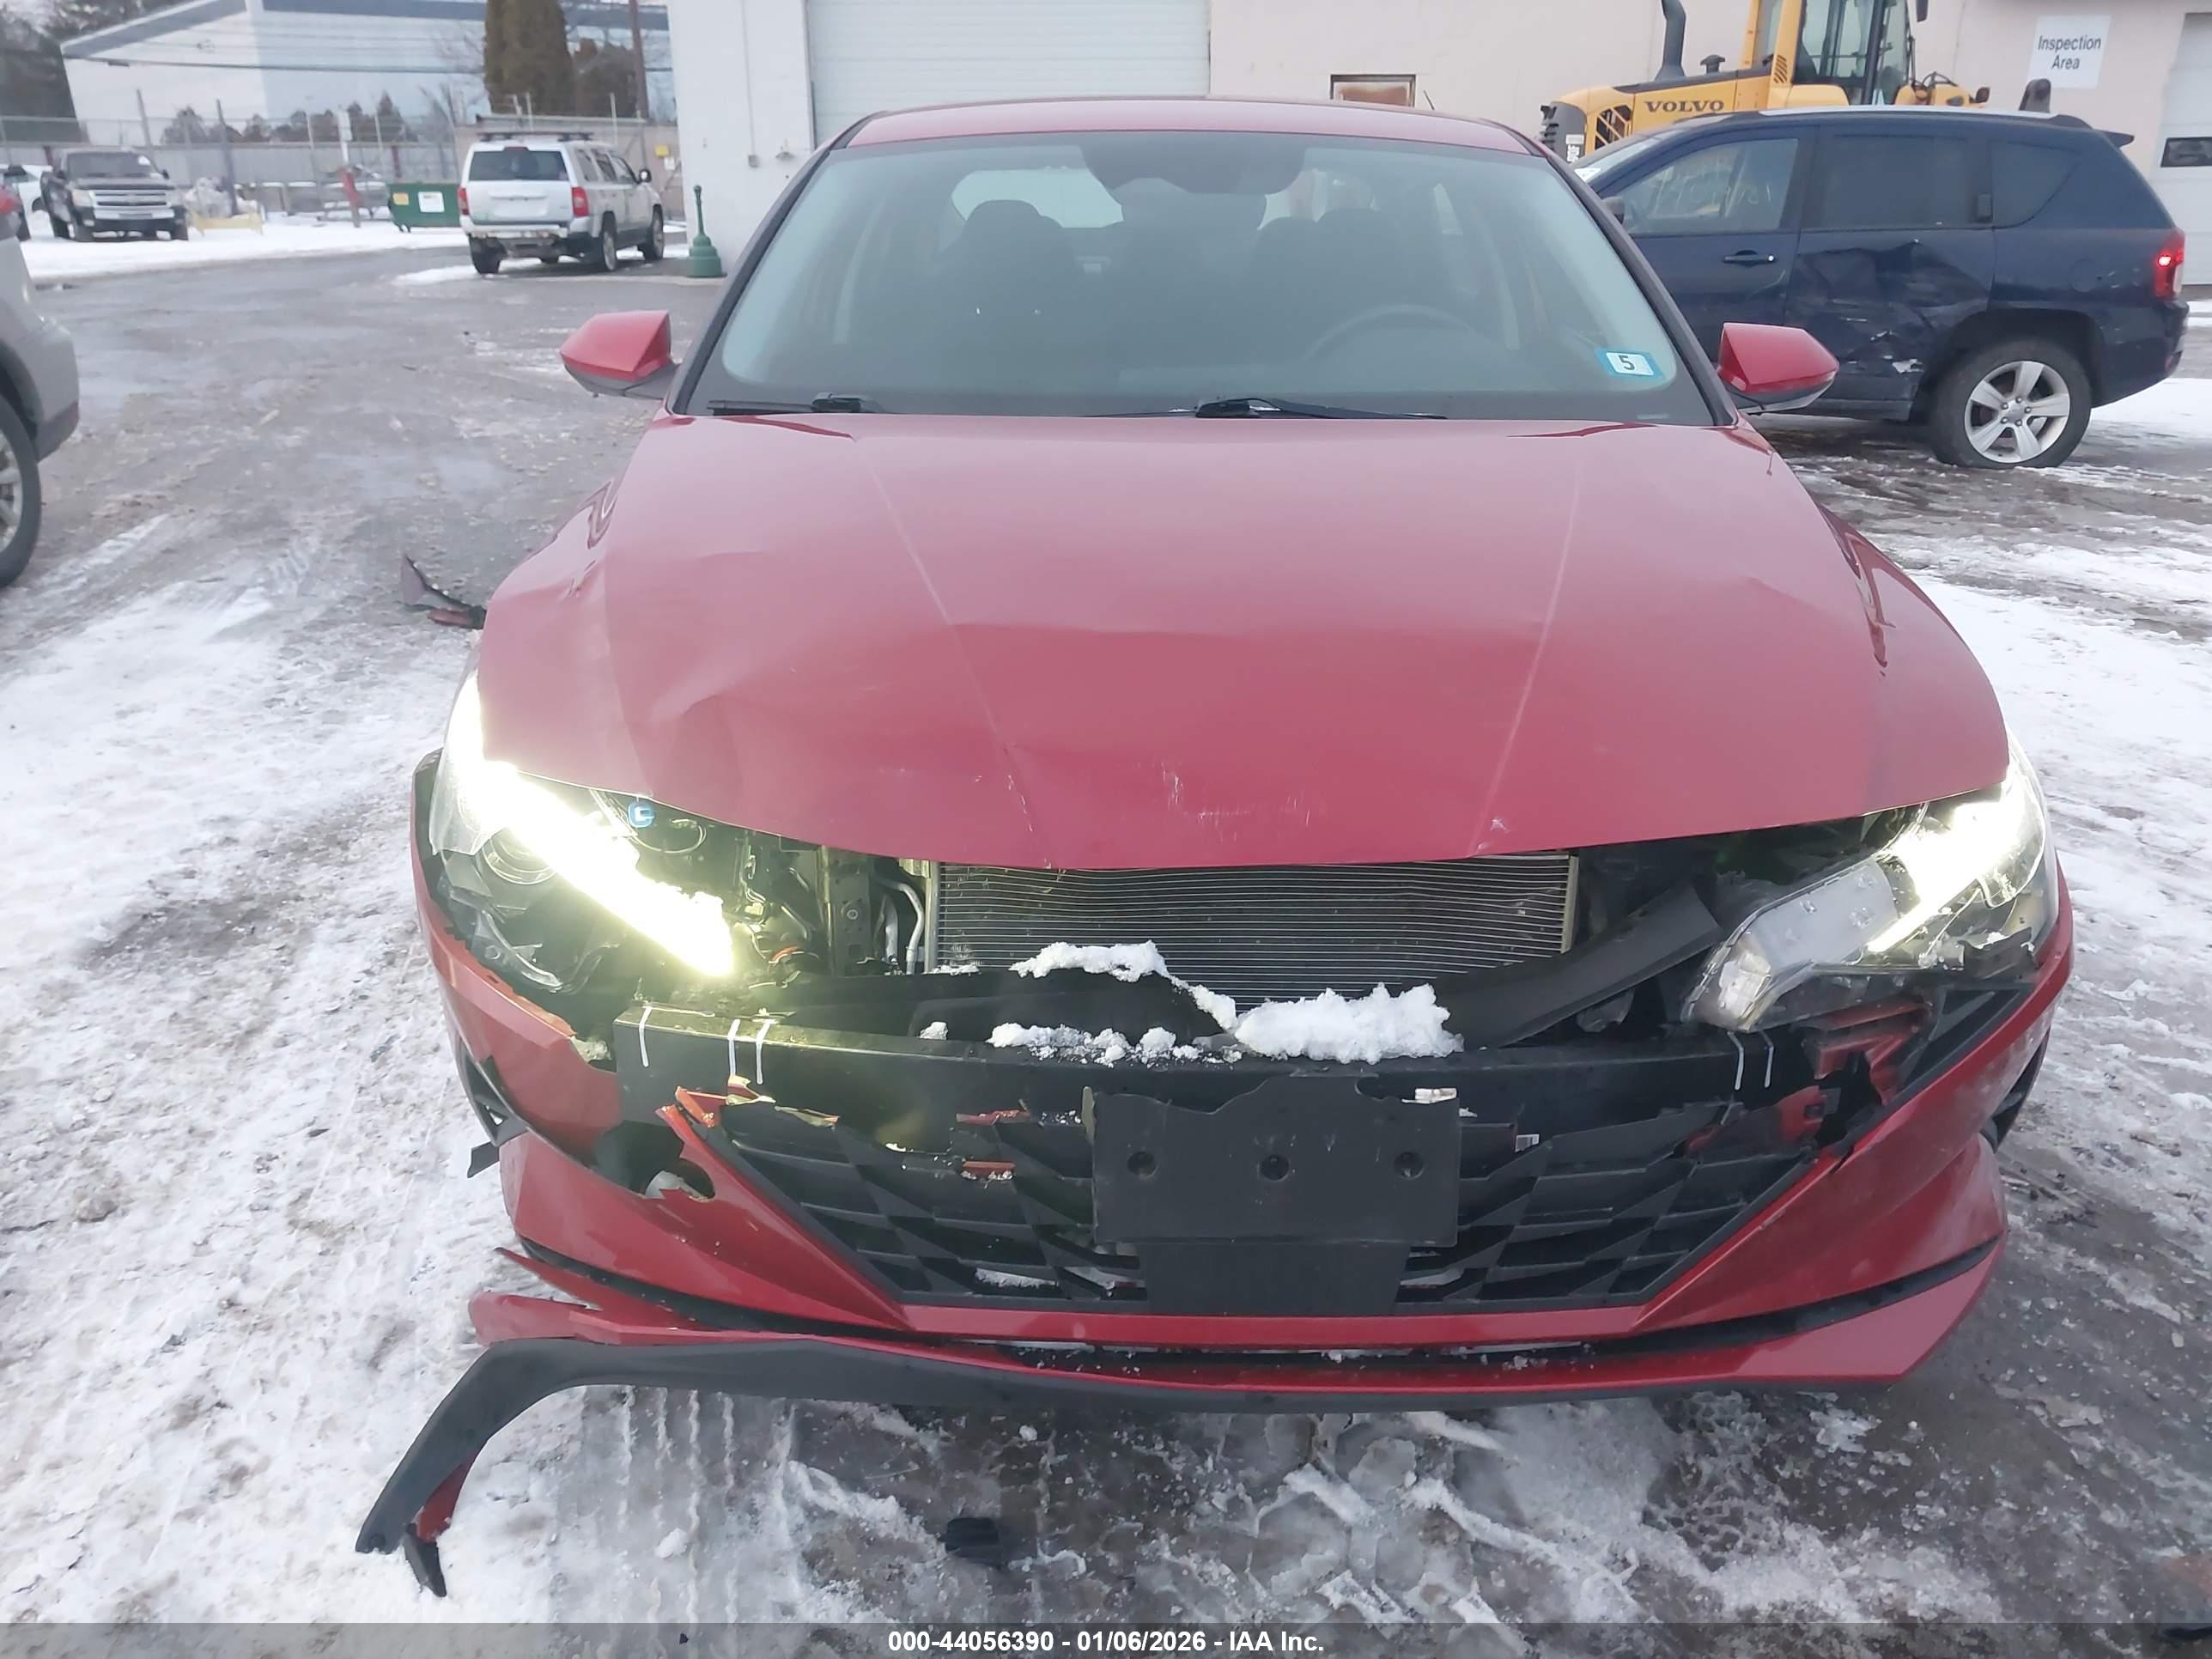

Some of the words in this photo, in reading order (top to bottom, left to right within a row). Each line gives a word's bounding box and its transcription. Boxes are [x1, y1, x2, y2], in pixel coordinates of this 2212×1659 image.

[2038, 34, 2101, 52] Inspection
[2051, 54, 2081, 70] Area
[1644, 100, 1725, 112] VOLVO
[1618, 355, 1635, 371] 5
